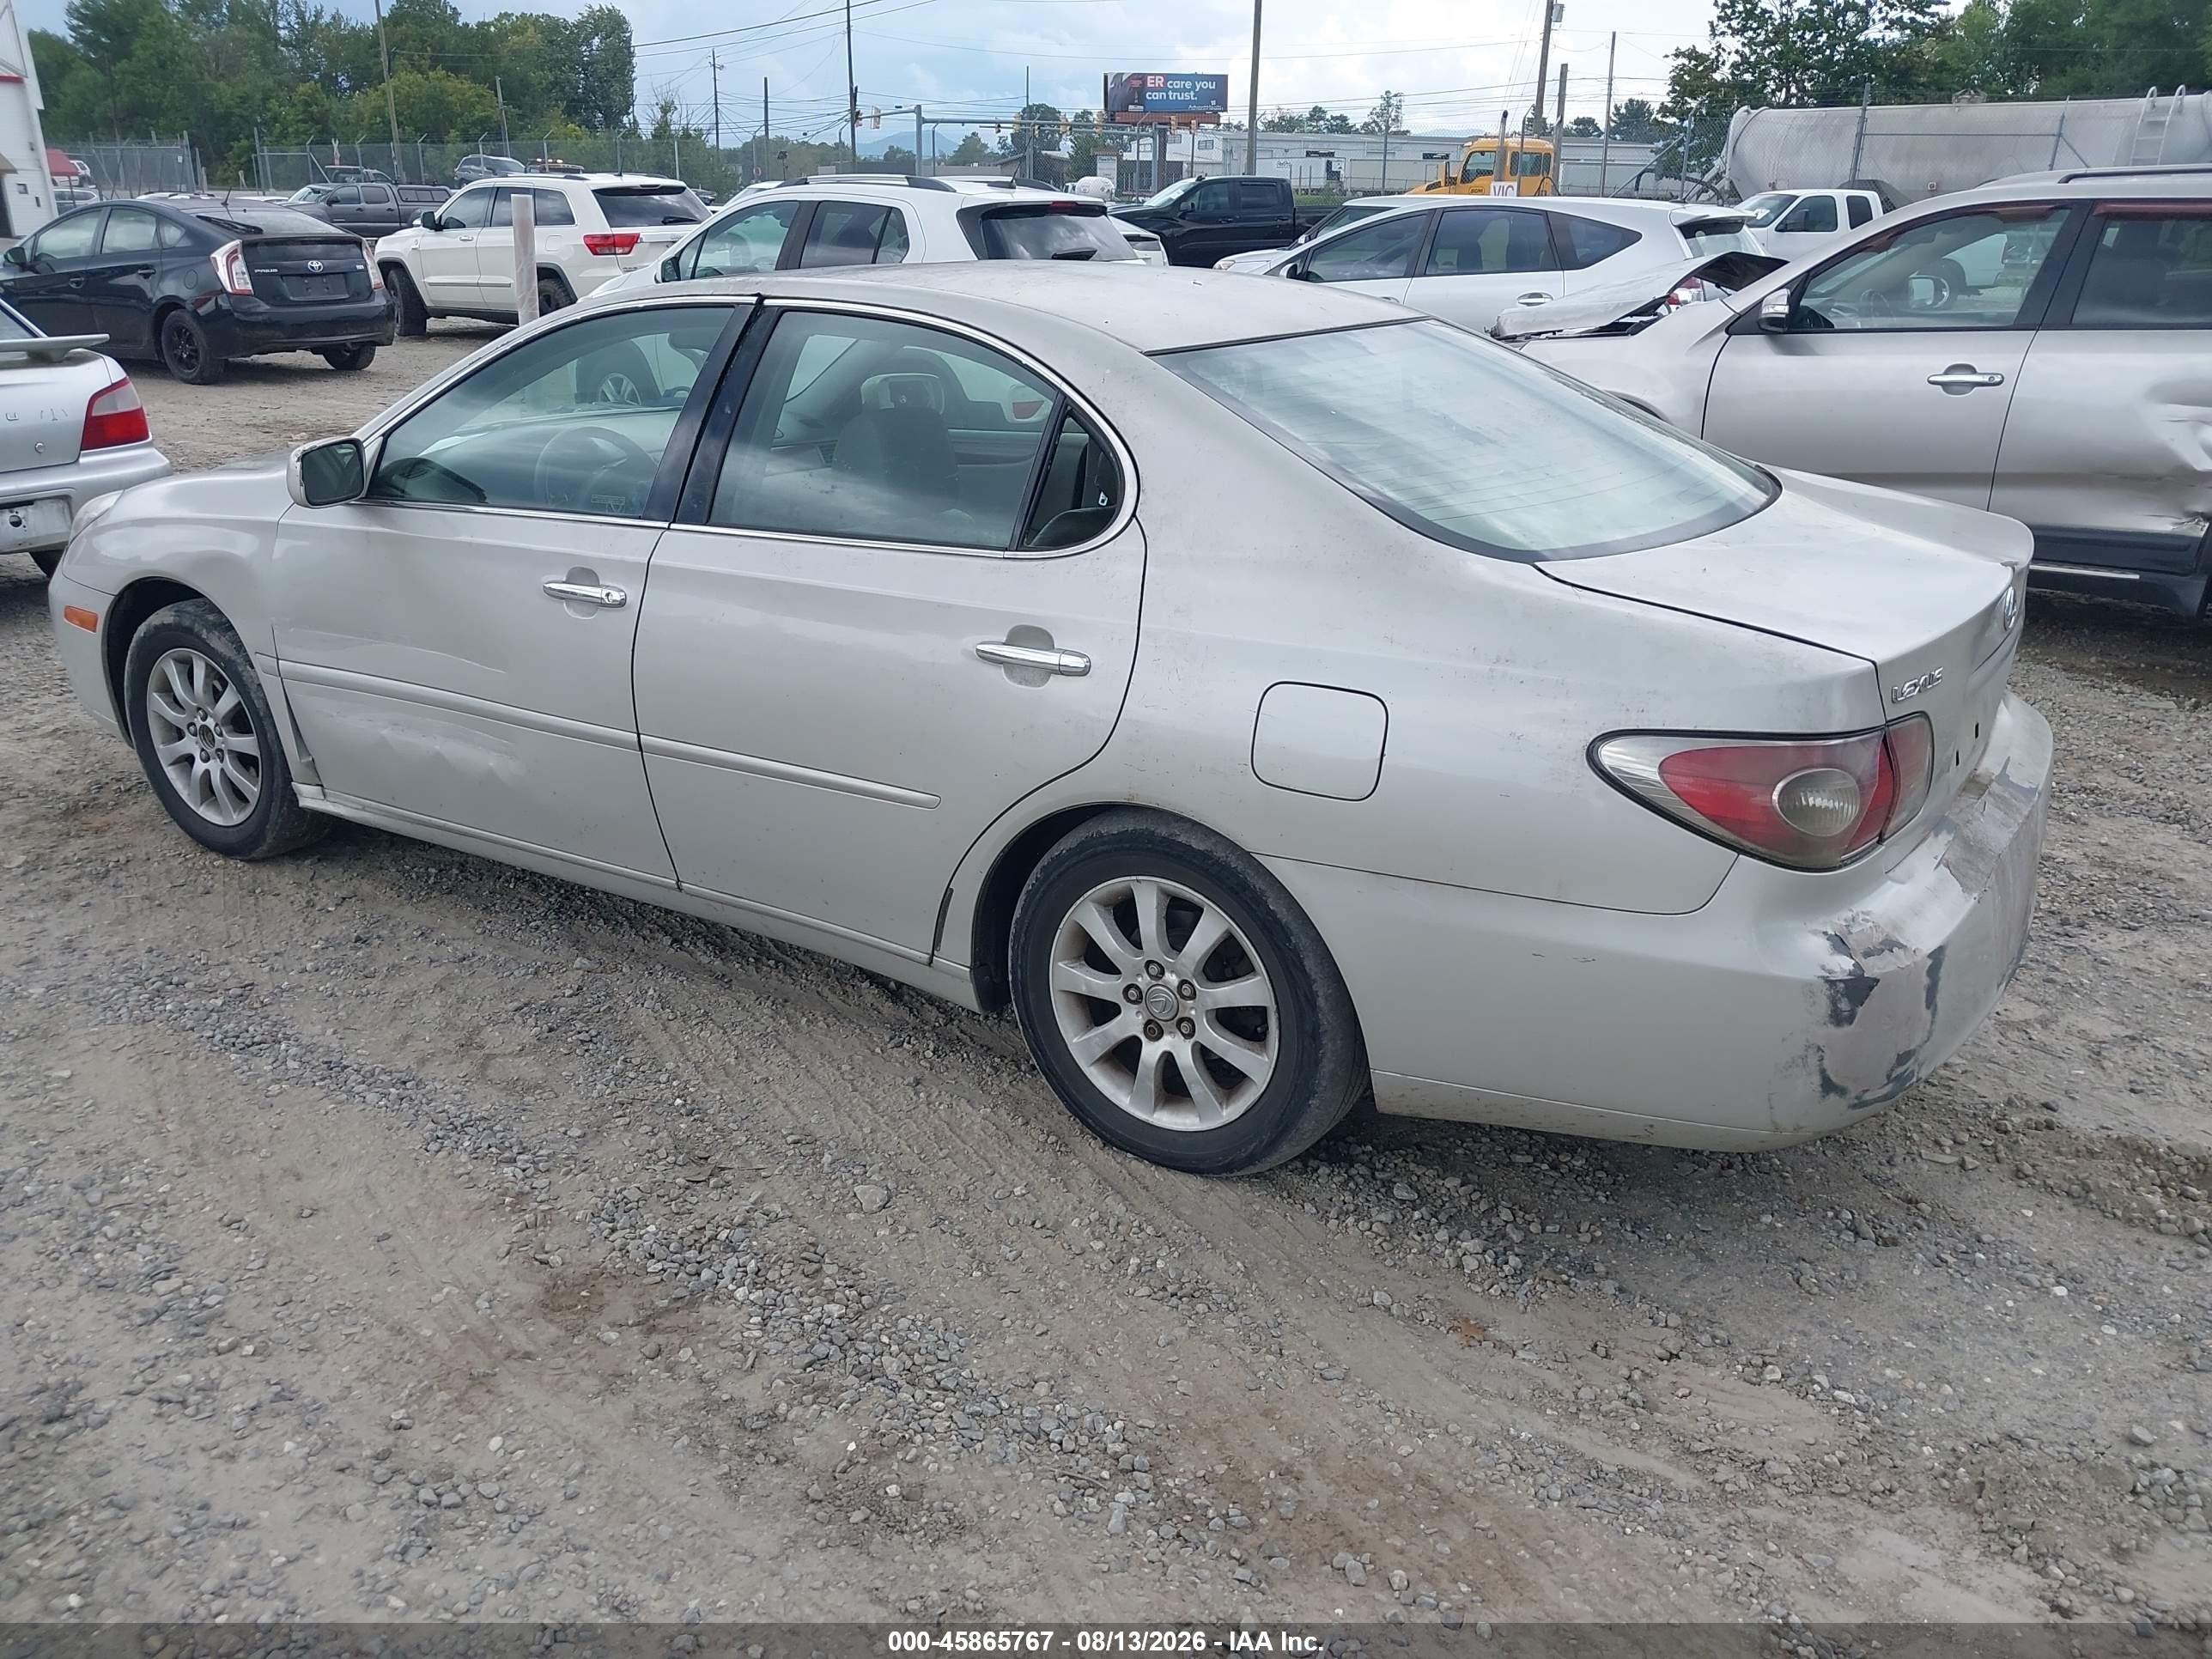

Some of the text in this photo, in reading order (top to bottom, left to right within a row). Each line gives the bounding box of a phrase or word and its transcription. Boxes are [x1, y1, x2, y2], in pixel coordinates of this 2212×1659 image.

[1146, 75, 1164, 87] ER
[1167, 80, 1192, 89] care
[1194, 81, 1216, 91] you
[1146, 91, 1198, 100] can trust.
[1892, 666, 1943, 703] LEXUS
